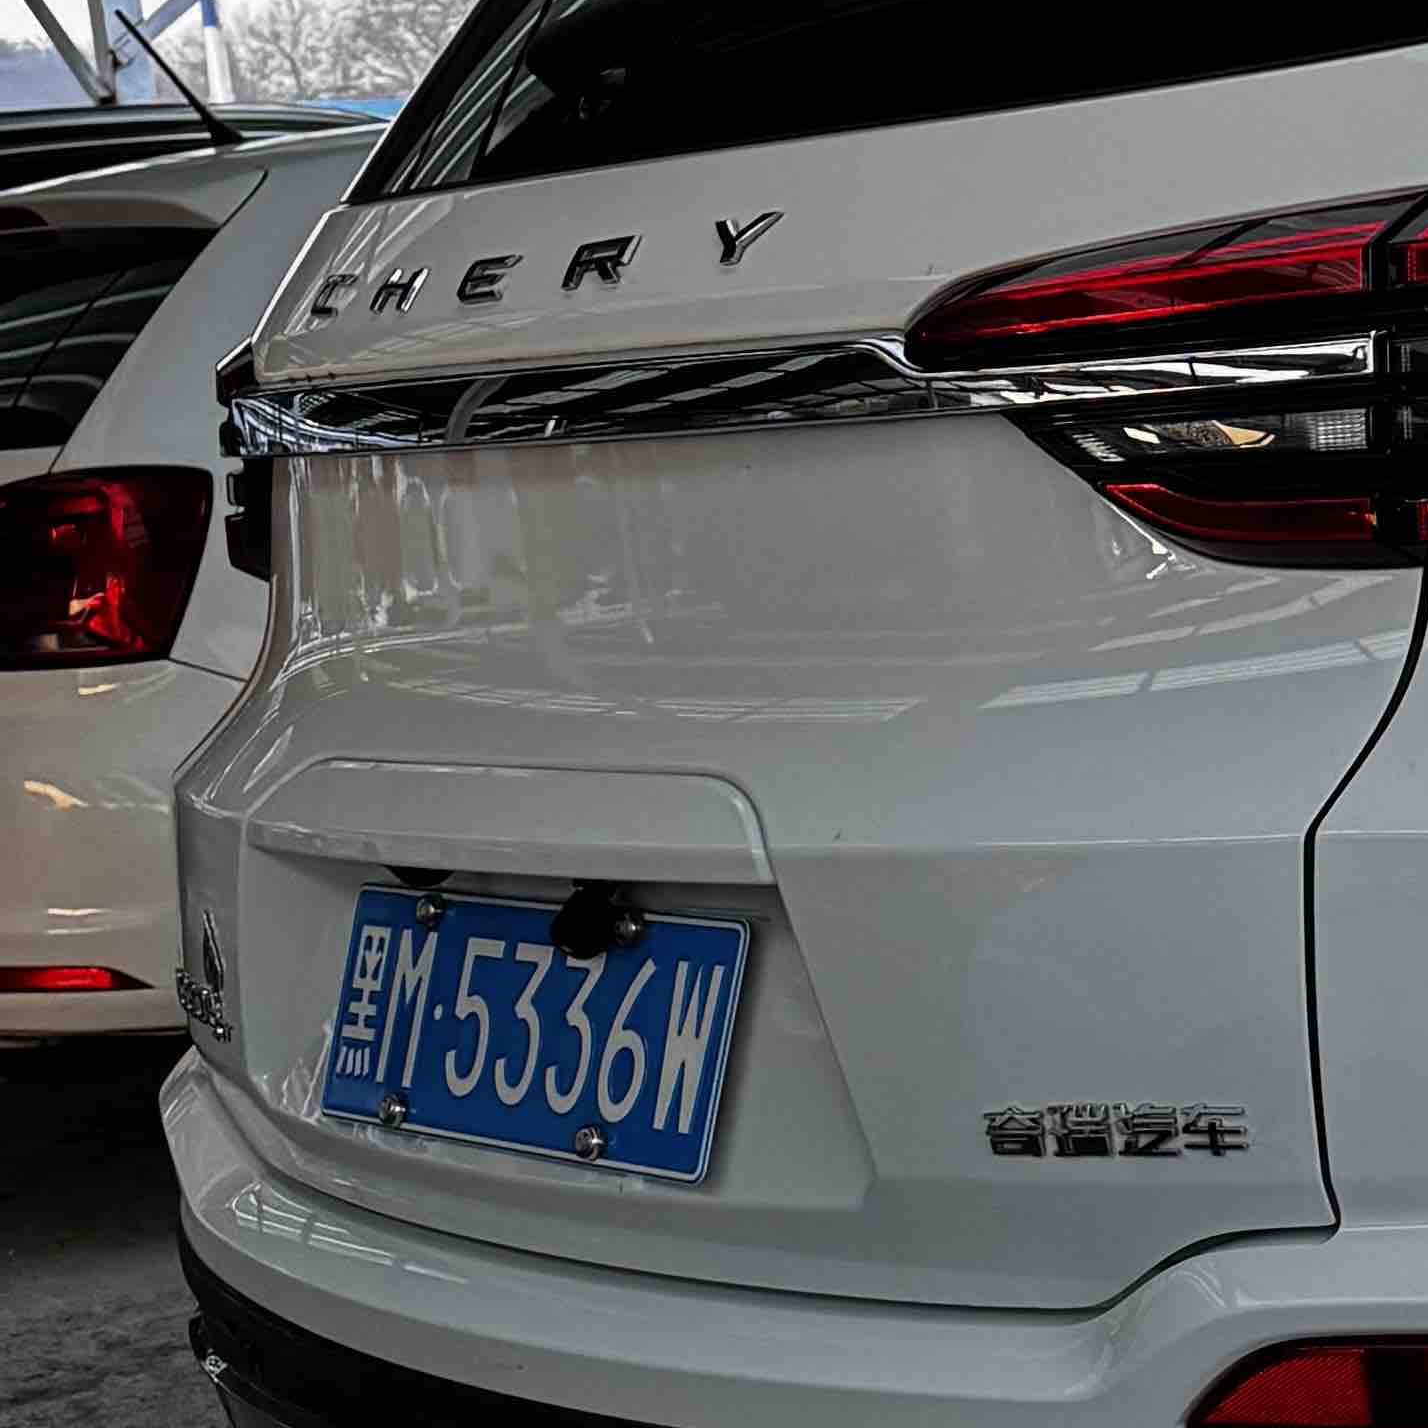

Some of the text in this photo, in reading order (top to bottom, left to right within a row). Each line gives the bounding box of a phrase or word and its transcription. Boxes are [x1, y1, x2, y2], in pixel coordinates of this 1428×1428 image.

[310, 211, 784, 316] CHERY
[984, 1103, 1248, 1158] 奇瑞汽车
